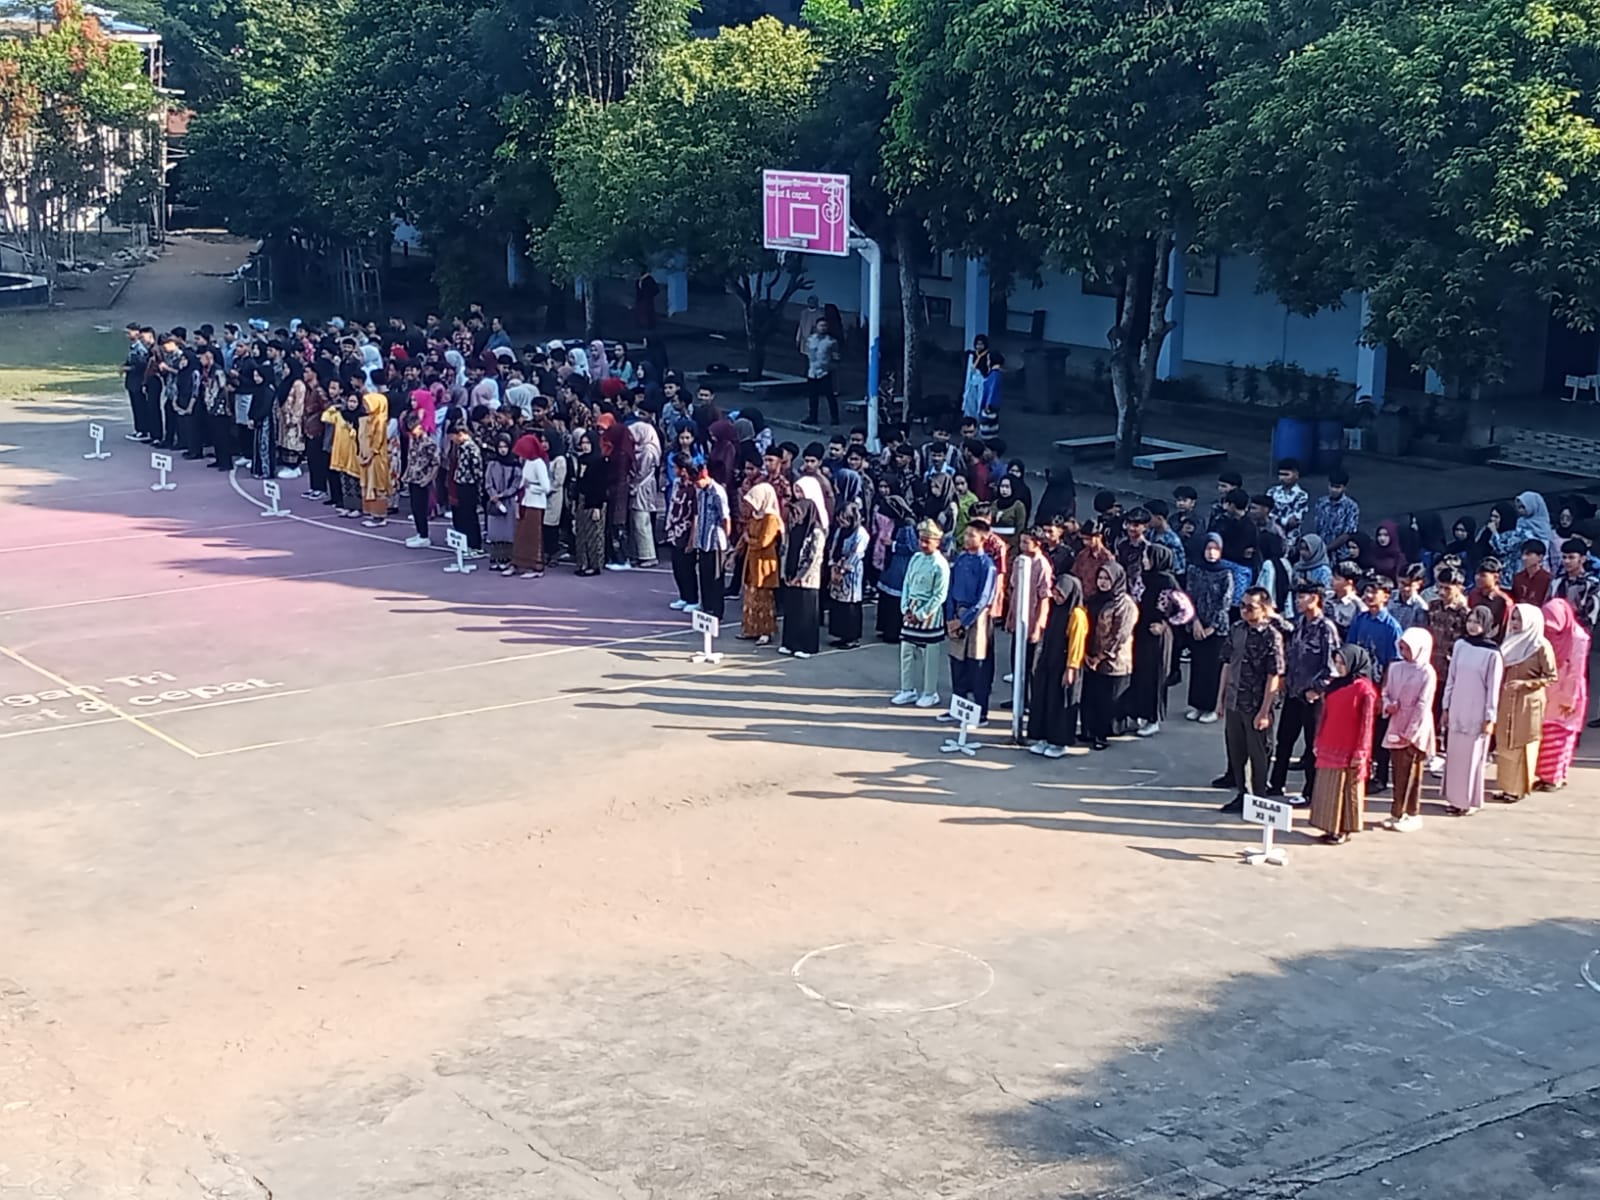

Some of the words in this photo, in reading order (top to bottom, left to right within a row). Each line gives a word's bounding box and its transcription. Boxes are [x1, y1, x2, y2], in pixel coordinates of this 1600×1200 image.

[0, 685, 104, 707] gan
[104, 670, 178, 688] Tri
[1252, 799, 1281, 813] KELAS
